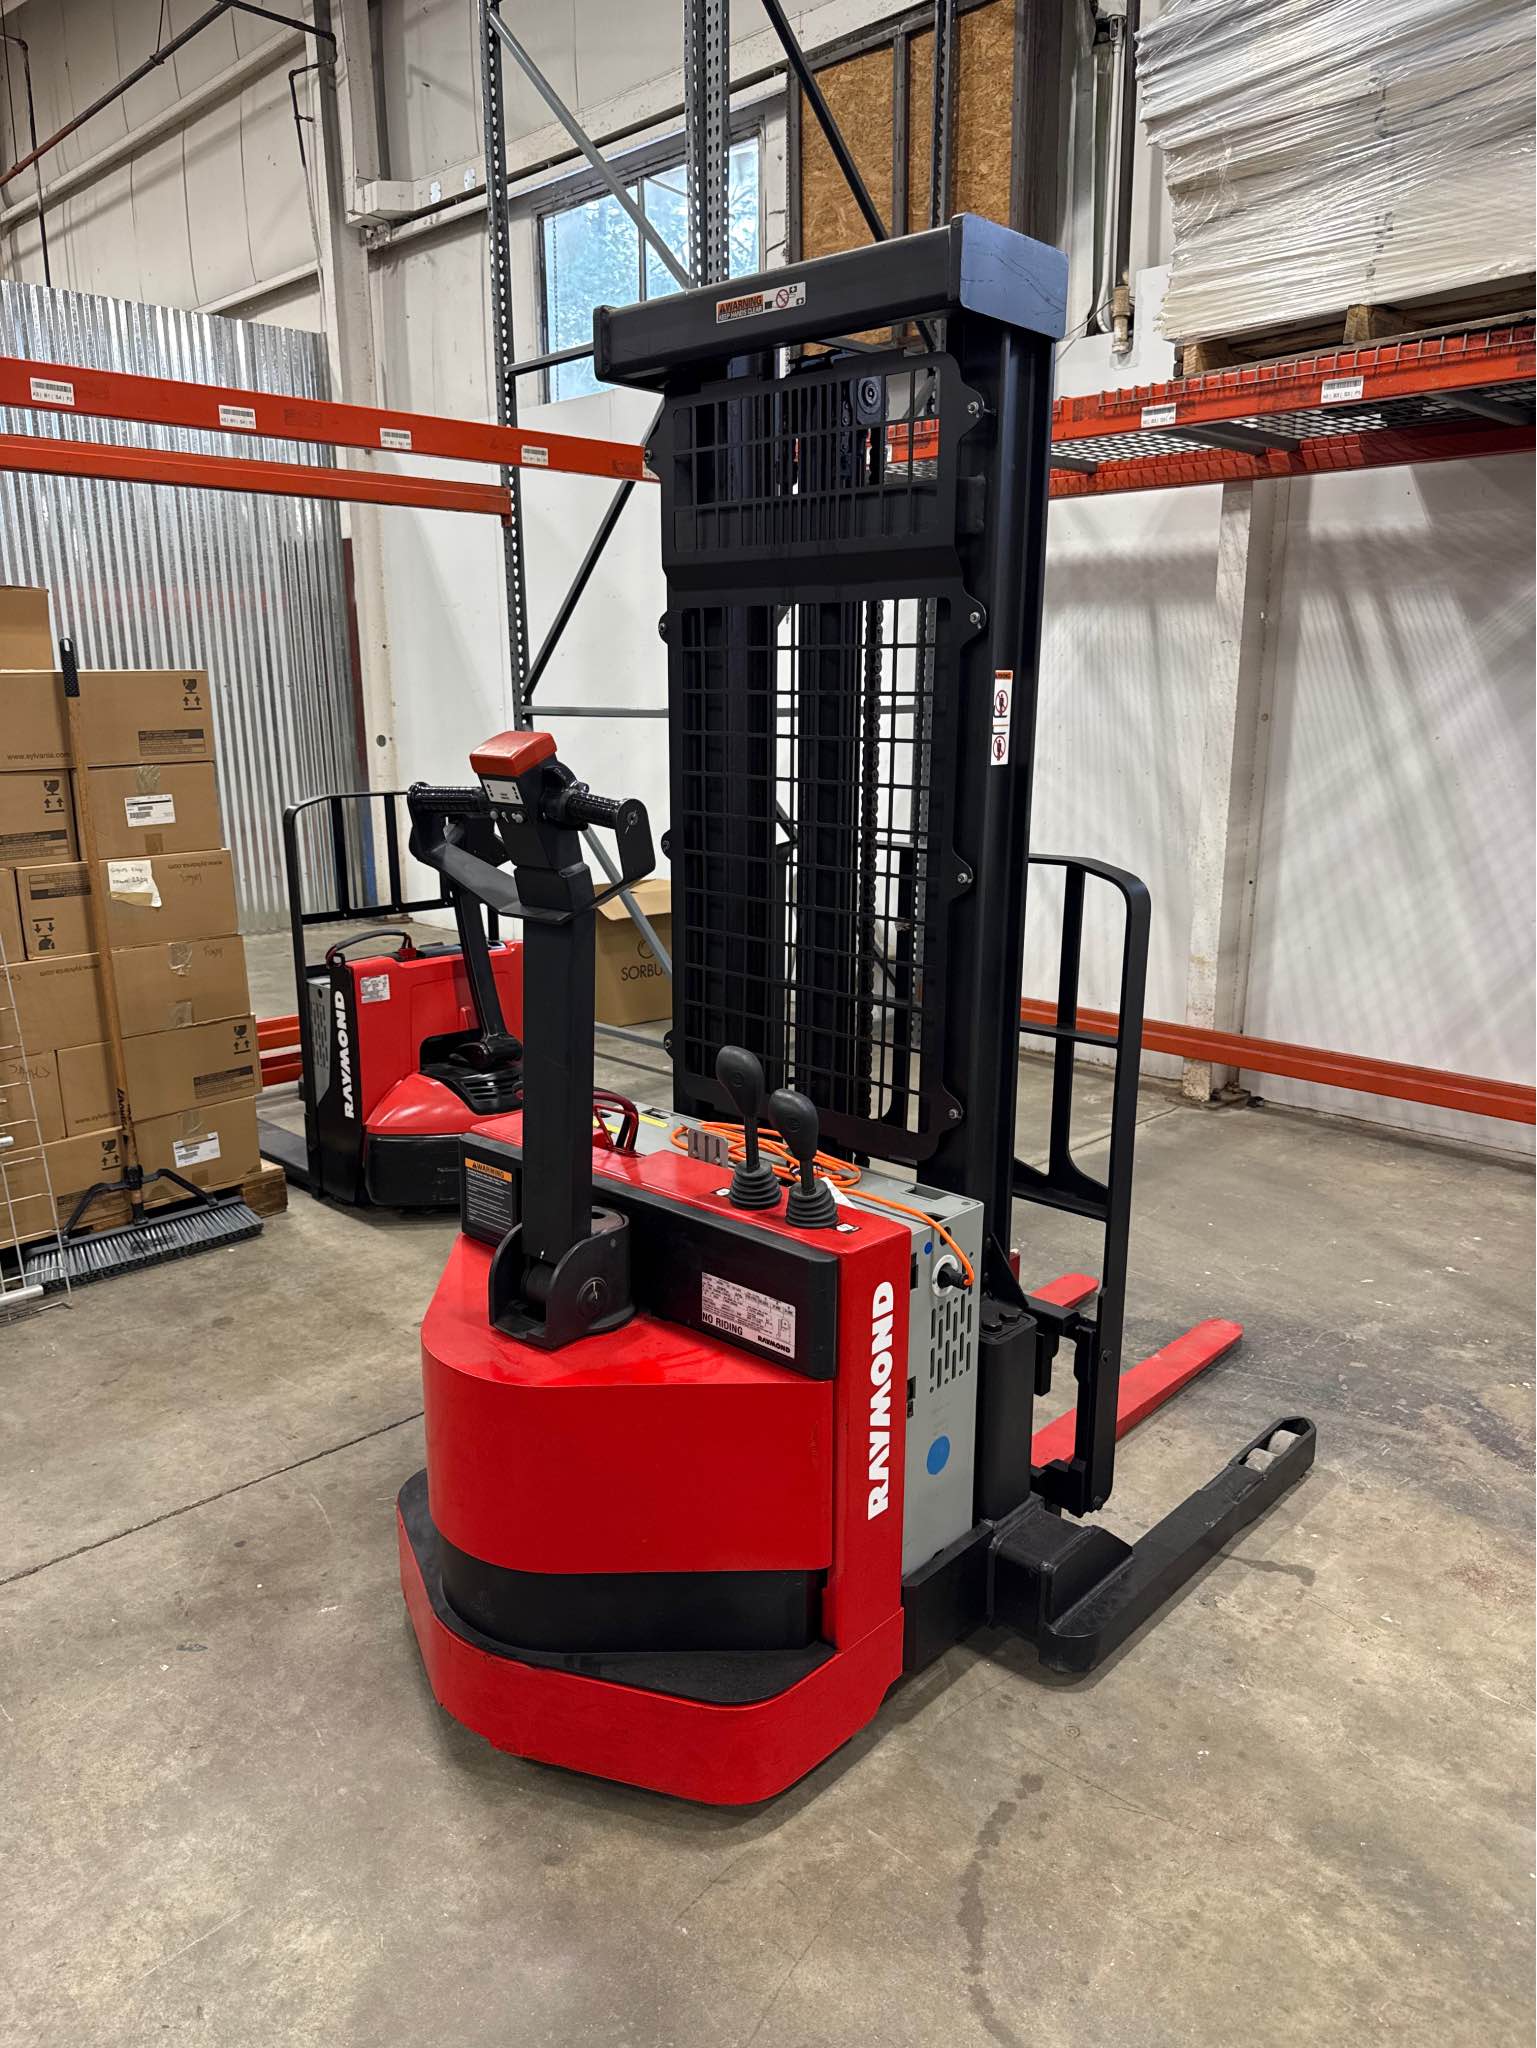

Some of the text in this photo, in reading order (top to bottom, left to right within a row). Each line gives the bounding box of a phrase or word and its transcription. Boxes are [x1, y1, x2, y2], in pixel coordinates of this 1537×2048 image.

[725, 295, 762, 311] WARNING
[621, 964, 666, 981] SORBU
[334, 990, 355, 1119] RAYMOND
[702, 1312, 743, 1336] NO RIDING
[757, 1335, 791, 1353] RAYMOND
[867, 1281, 894, 1520] RAYMOND
